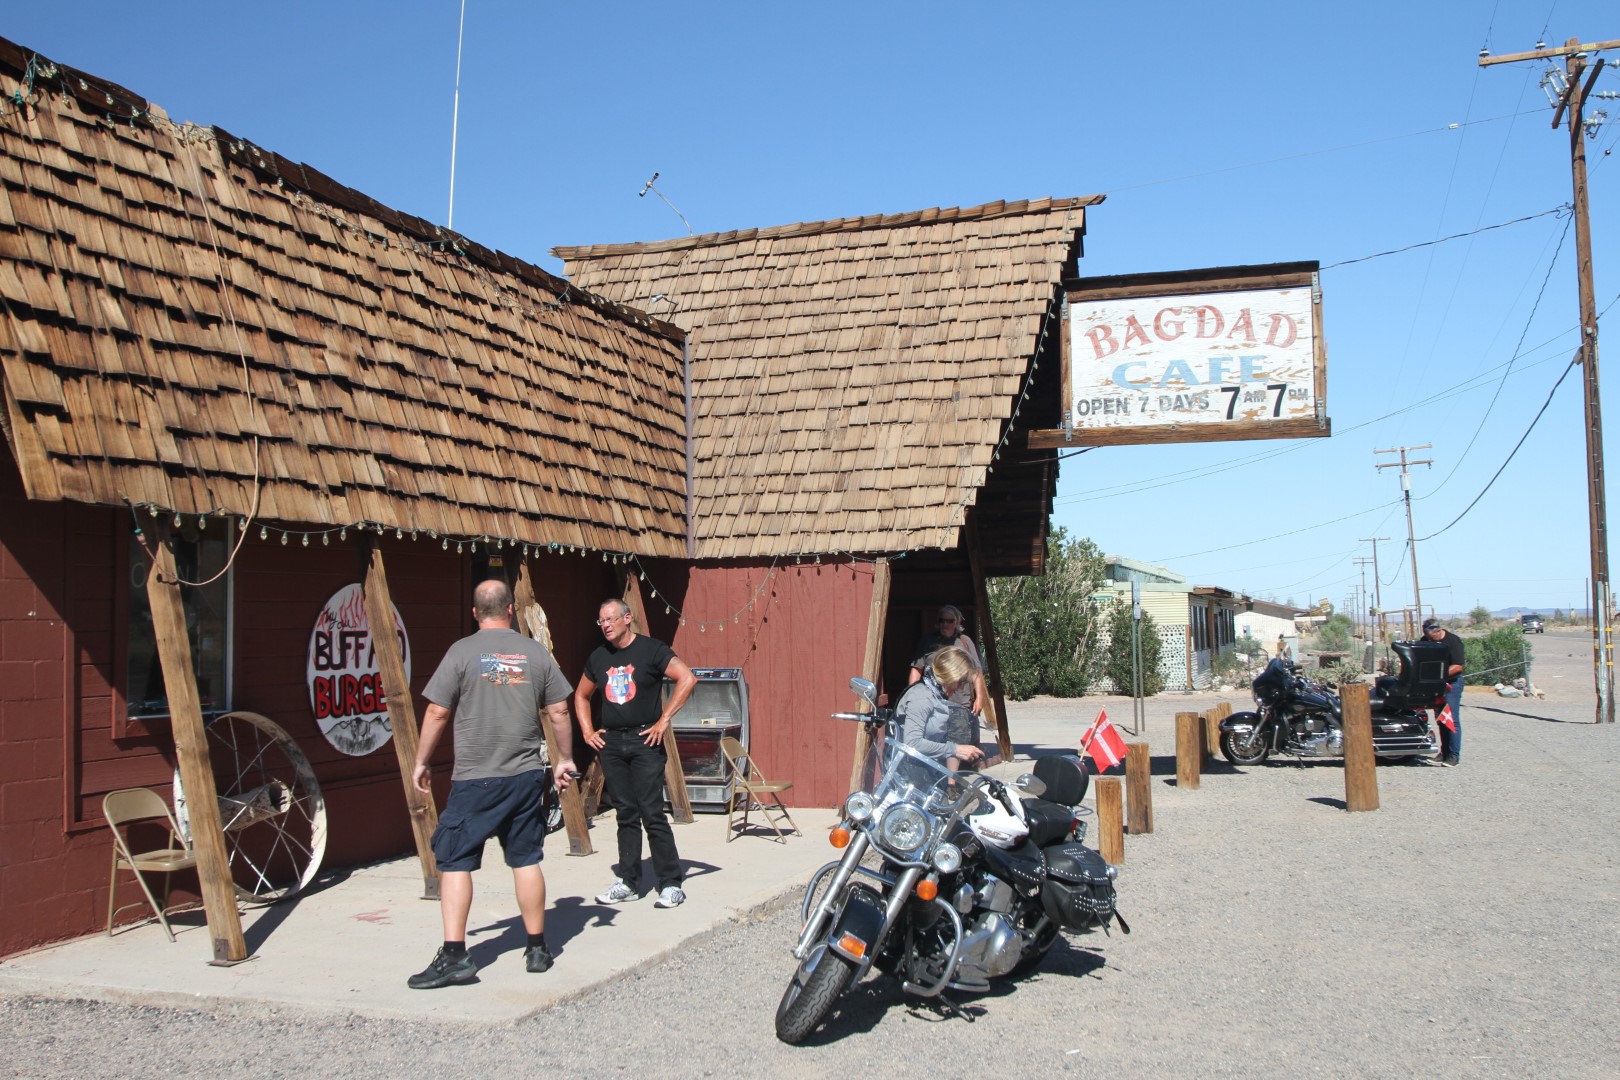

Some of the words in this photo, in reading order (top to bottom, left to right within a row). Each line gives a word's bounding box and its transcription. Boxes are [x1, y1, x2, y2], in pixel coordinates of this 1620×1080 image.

[1084, 304, 1298, 360] BAGDAD
[1112, 354, 1270, 390] CAFE
[1077, 397, 1128, 416] OPEN
[1138, 395, 1150, 413] 7
[1159, 392, 1210, 413] DAYS
[1221, 386, 1241, 420] 7
[1267, 383, 1287, 418] 7
